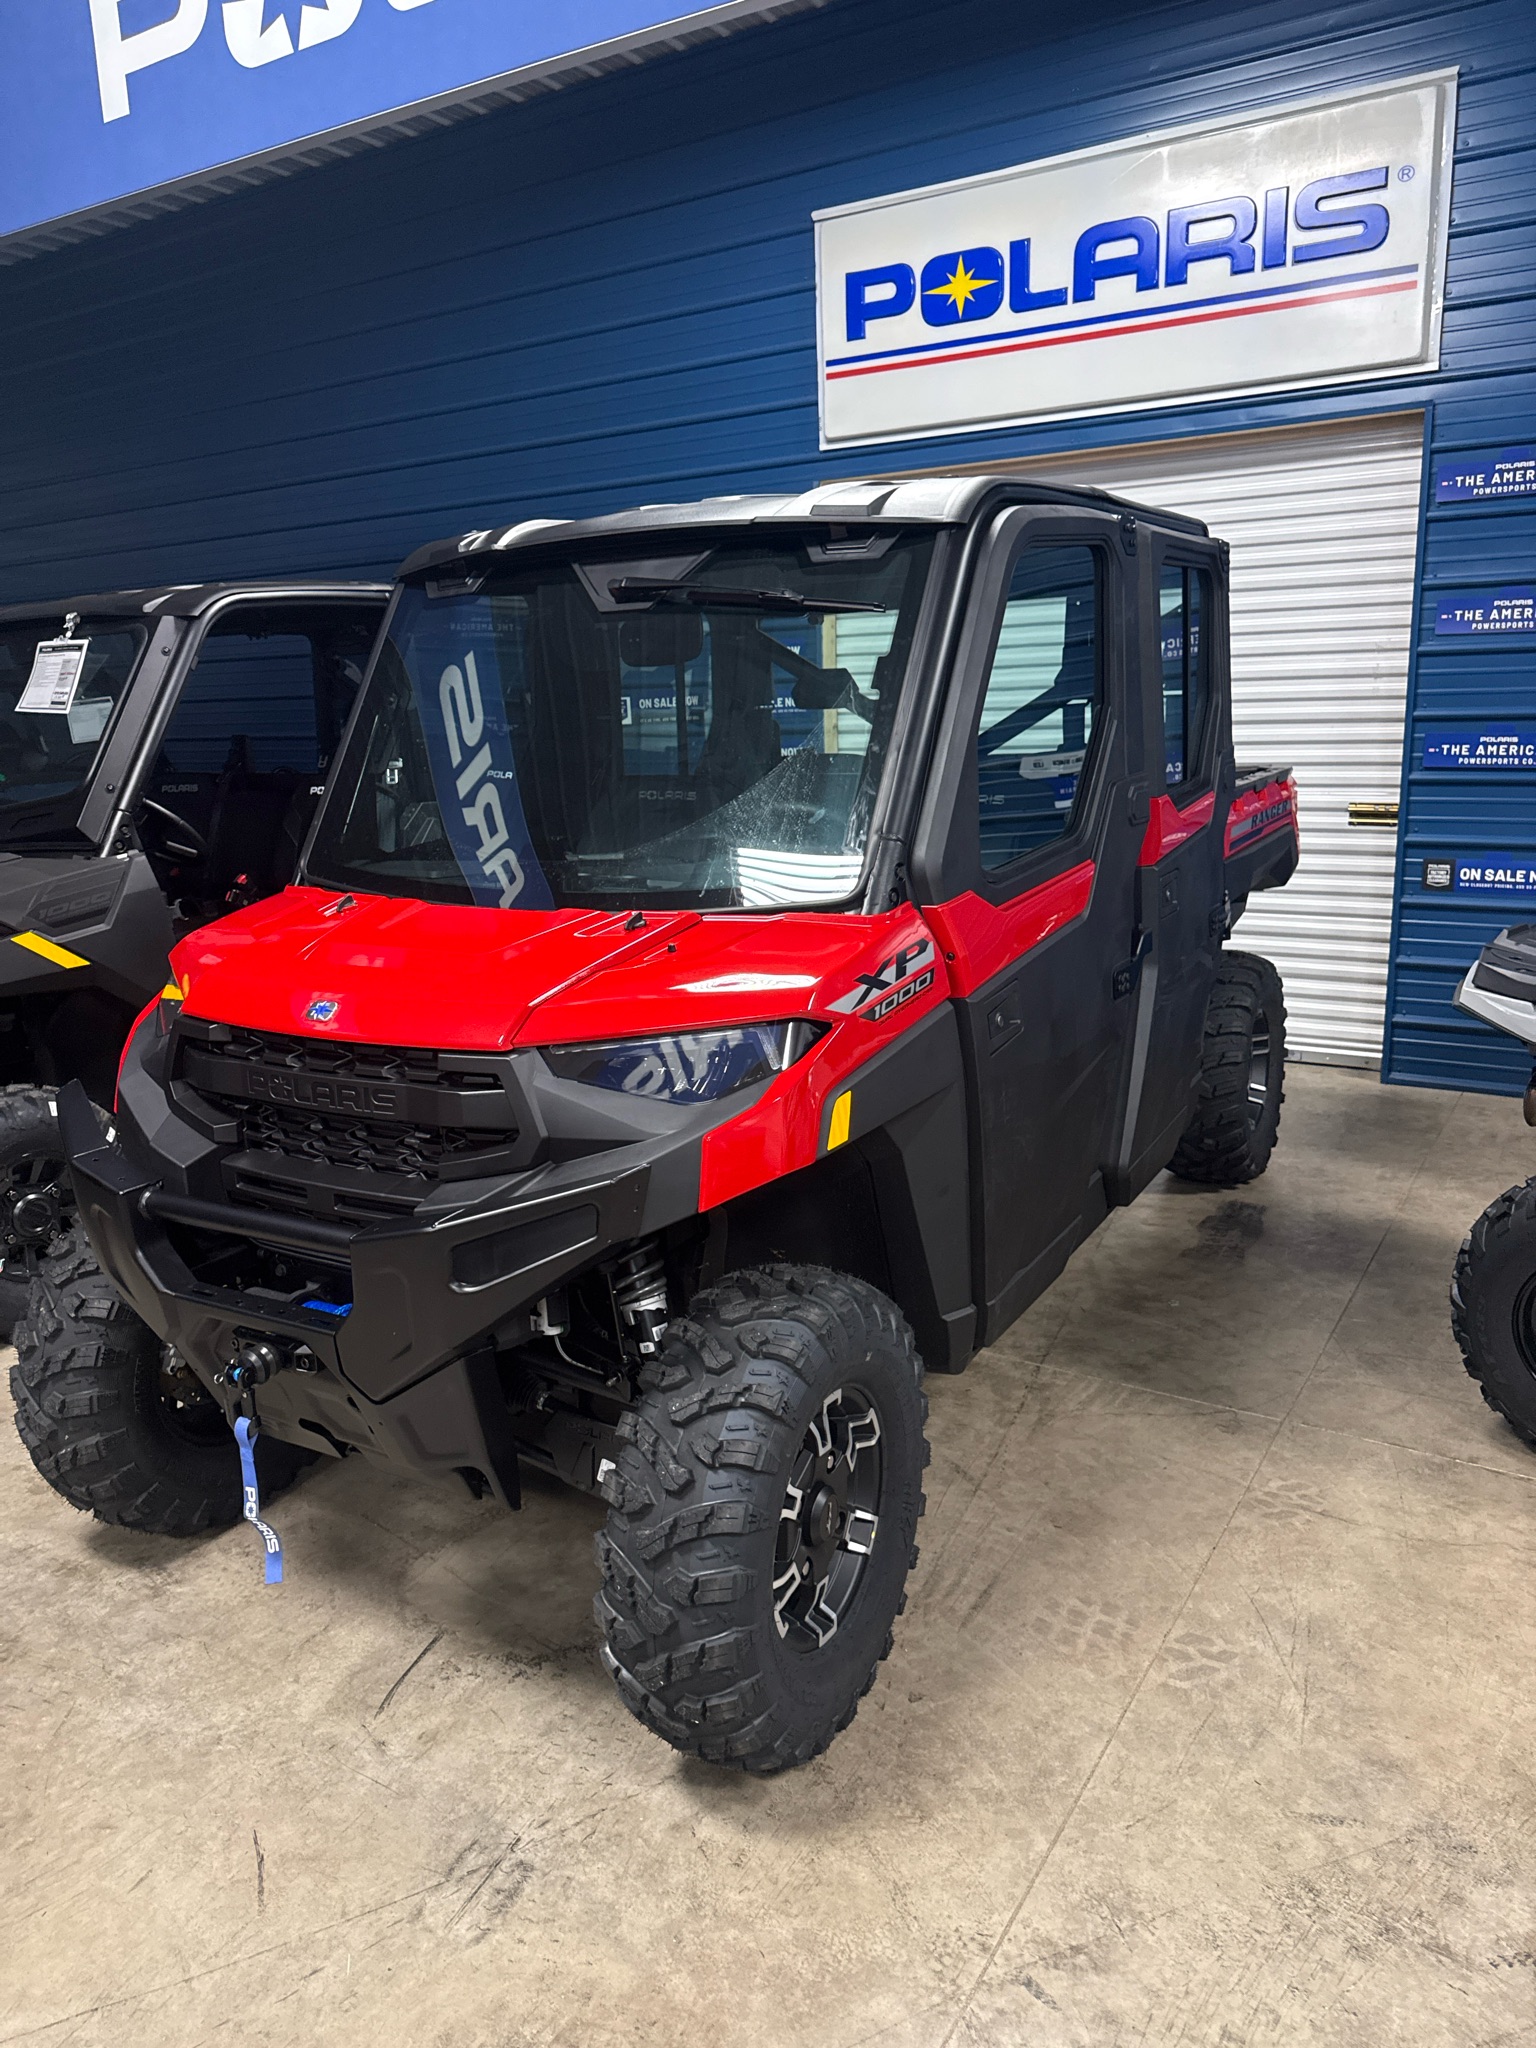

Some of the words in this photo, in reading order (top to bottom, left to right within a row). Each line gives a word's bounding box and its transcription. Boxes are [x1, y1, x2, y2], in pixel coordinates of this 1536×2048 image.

[845, 166, 1390, 341] POLARIS
[1495, 461, 1536, 470] POLARIS
[1455, 474, 1485, 487] THE
[1473, 483, 1536, 495] POWERSPORTS
[1454, 610, 1484, 621] THE
[1472, 621, 1534, 630] POWERSPORTS
[639, 698, 653, 709] ON
[653, 697, 677, 708] SALE
[1441, 744, 1470, 755] THE
[1475, 744, 1536, 756] AMERIC
[1458, 757, 1519, 765] POWERSPORTS
[1522, 757, 1536, 765] CO.
[161, 783, 199, 793] POLARIS
[638, 790, 697, 801] POLARIS
[1250, 799, 1288, 830] RANGER
[1459, 868, 1481, 881] ON
[1484, 868, 1526, 883] SALE
[850, 937, 930, 1012] XP
[873, 970, 932, 1020] 1000
[248, 1072, 397, 1116] POLARIS
[243, 1486, 280, 1554] POLARIS
